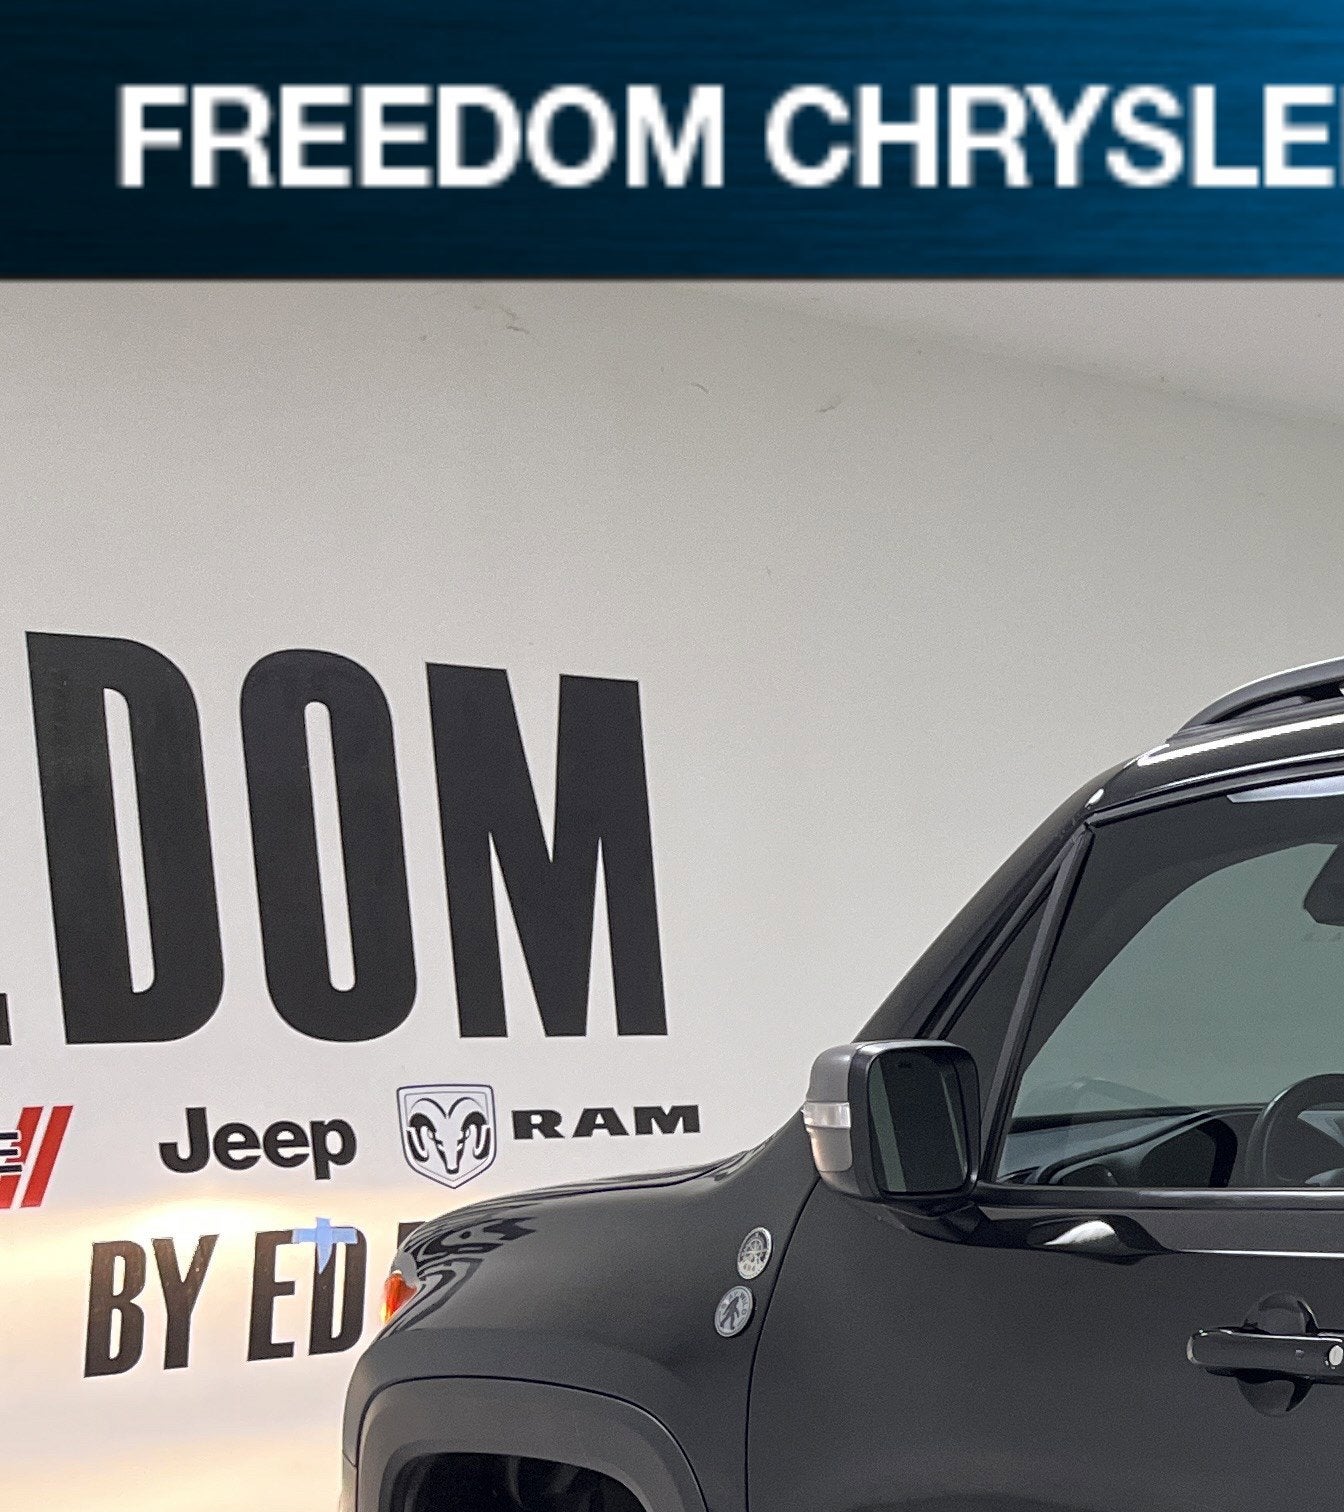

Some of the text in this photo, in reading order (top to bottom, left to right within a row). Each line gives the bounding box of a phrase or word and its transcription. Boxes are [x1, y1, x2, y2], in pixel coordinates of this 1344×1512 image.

[0, 630, 669, 1046] DOM
[159, 1106, 357, 1180] Jeep
[511, 1104, 702, 1141] RAM
[83, 1223, 369, 1379] BY ED
